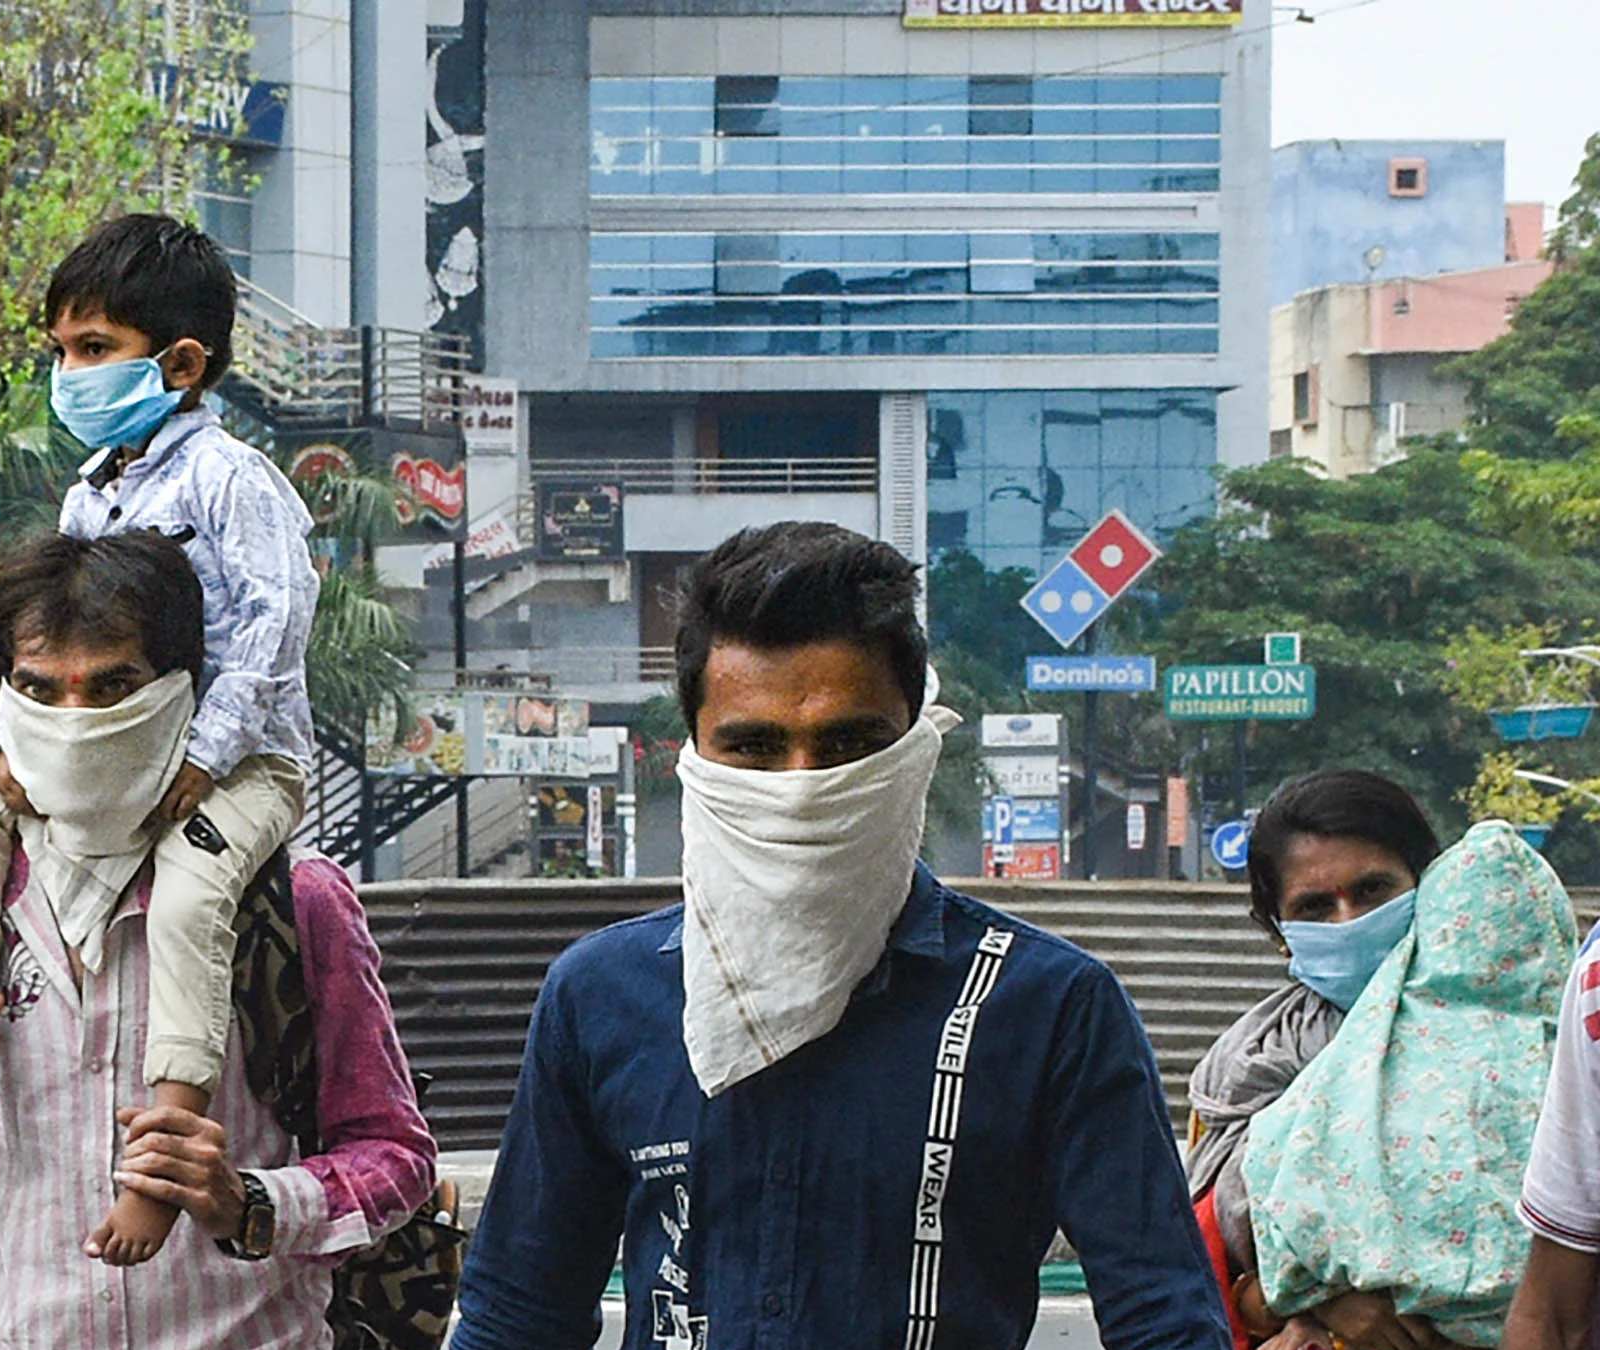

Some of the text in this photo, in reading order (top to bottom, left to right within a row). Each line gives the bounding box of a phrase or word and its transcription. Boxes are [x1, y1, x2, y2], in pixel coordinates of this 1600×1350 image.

[1032, 662, 1145, 686] Domino's
[1171, 668, 1306, 696] PAPILLON
[918, 1008, 973, 1231] STILE WEAR
